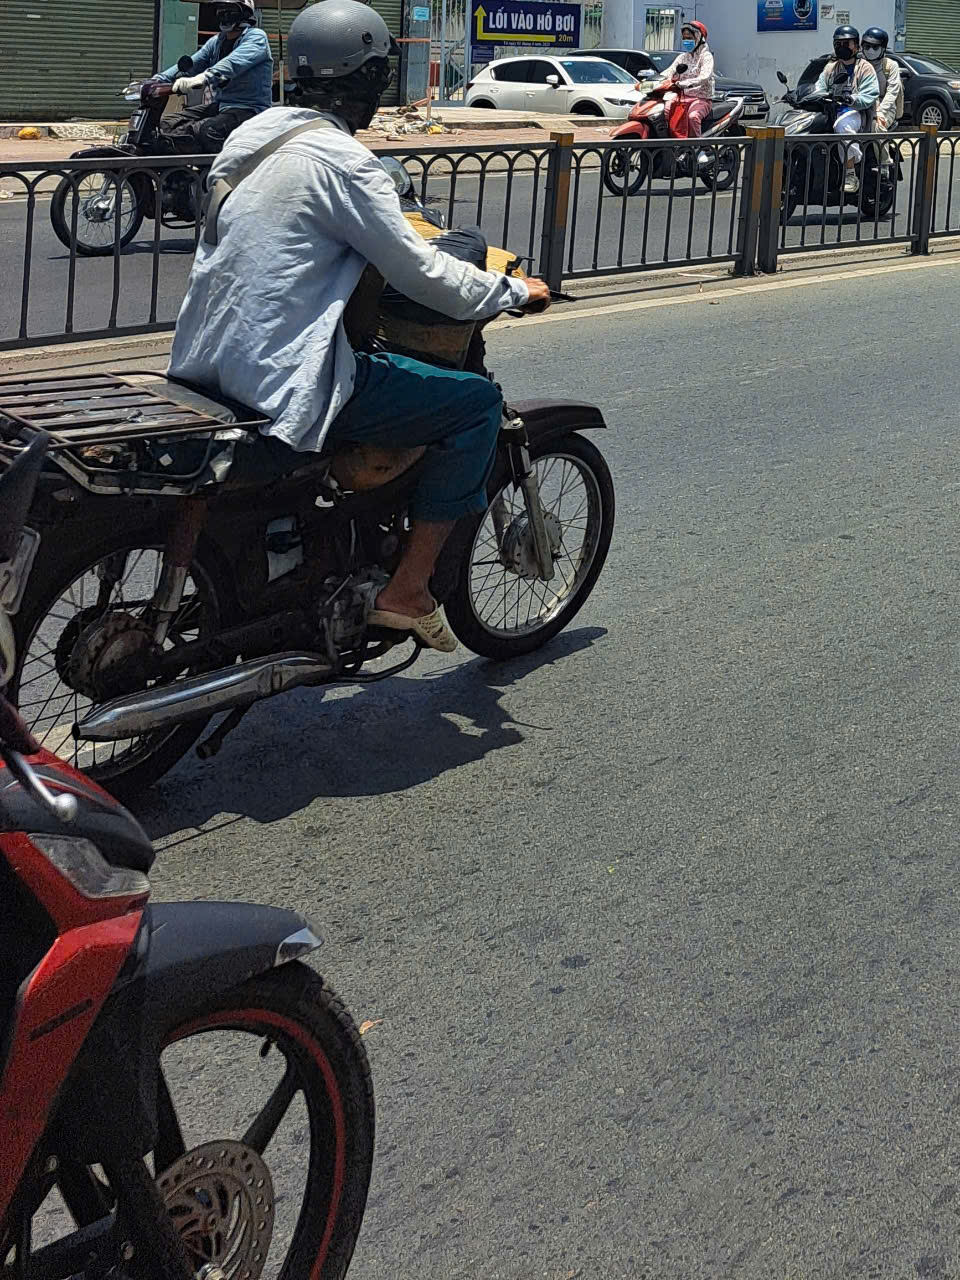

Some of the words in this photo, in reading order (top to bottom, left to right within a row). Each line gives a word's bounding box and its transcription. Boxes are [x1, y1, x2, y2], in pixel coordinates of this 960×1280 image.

[489, 7, 507, 29] LỐI
[511, 10, 533, 30] VÀO
[537, 9, 552, 31] HỒ
[556, 14, 575, 32] BƠI
